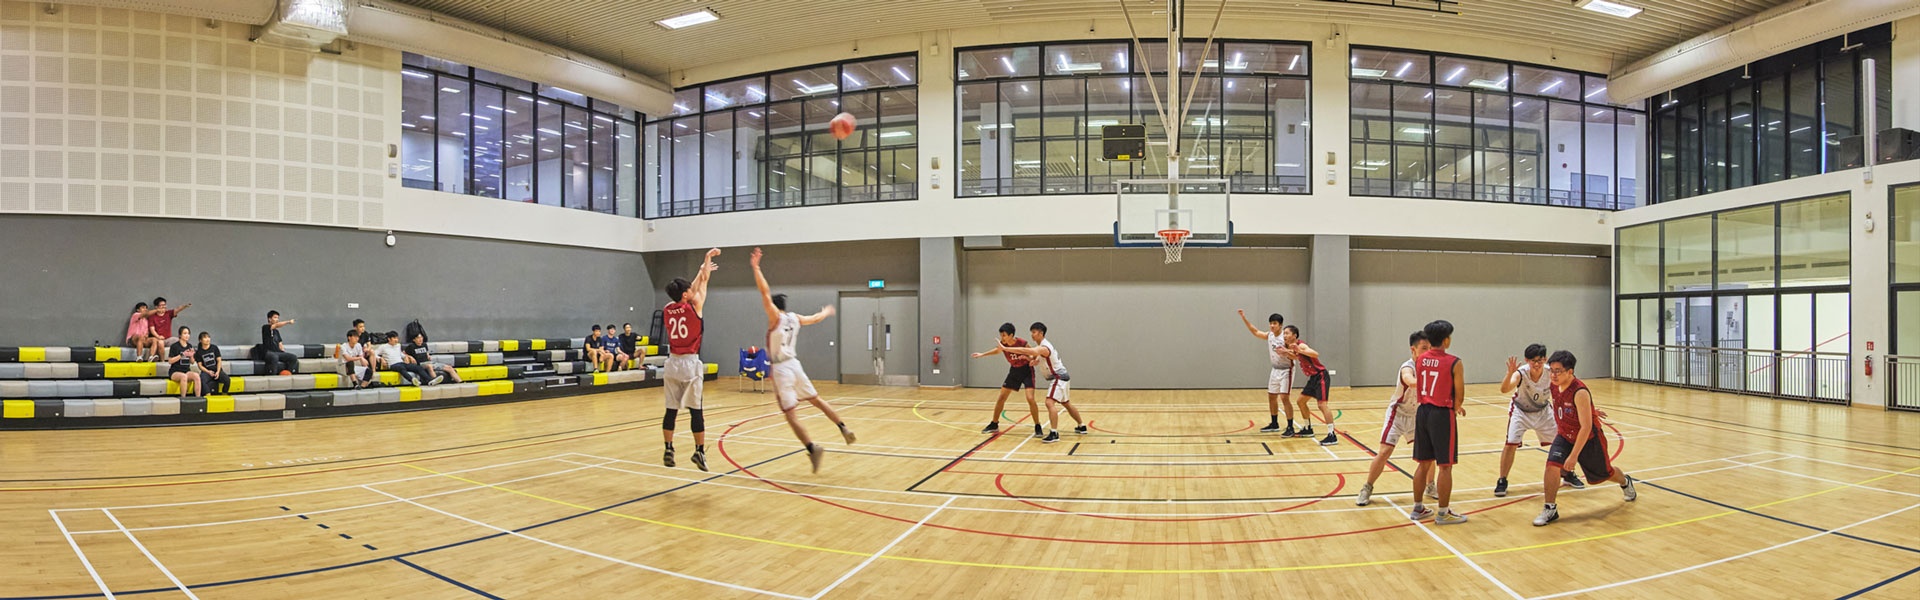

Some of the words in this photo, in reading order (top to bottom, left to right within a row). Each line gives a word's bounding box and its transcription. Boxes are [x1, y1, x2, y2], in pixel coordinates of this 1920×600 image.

[669, 317, 688, 340] 26
[1421, 358, 1440, 367] SUTD
[1421, 369, 1439, 397] 17
[1534, 393, 1540, 402] 0
[1558, 407, 1563, 420] 0
